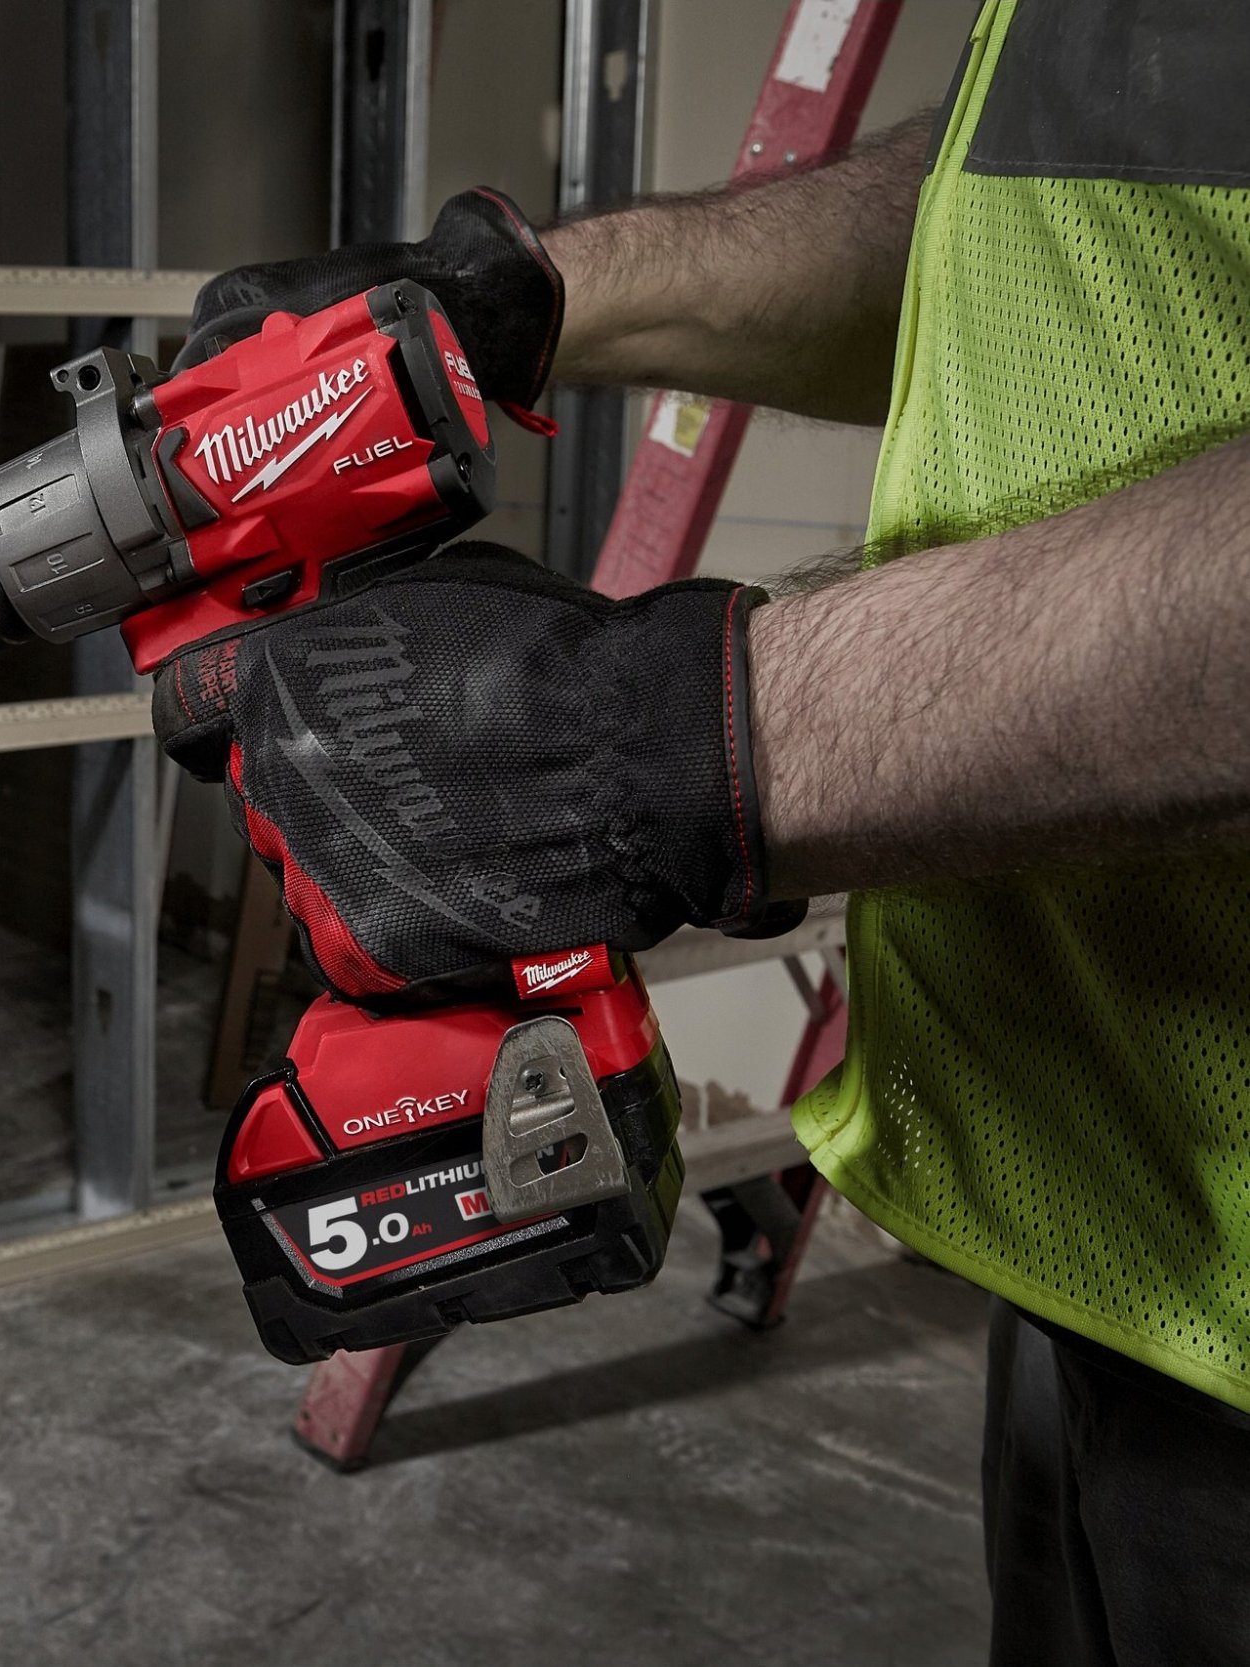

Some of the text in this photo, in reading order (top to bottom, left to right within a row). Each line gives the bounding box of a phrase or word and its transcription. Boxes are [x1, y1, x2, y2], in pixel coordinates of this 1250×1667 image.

[194, 358, 369, 486] Milwaukee
[332, 435, 414, 475] FUEL
[29, 493, 47, 514] 12
[46, 552, 68, 575] 10
[520, 949, 591, 987] Milwaukee
[361, 1160, 485, 1208] REDLITHIU
[307, 1196, 433, 1272] 5.0 Ah
